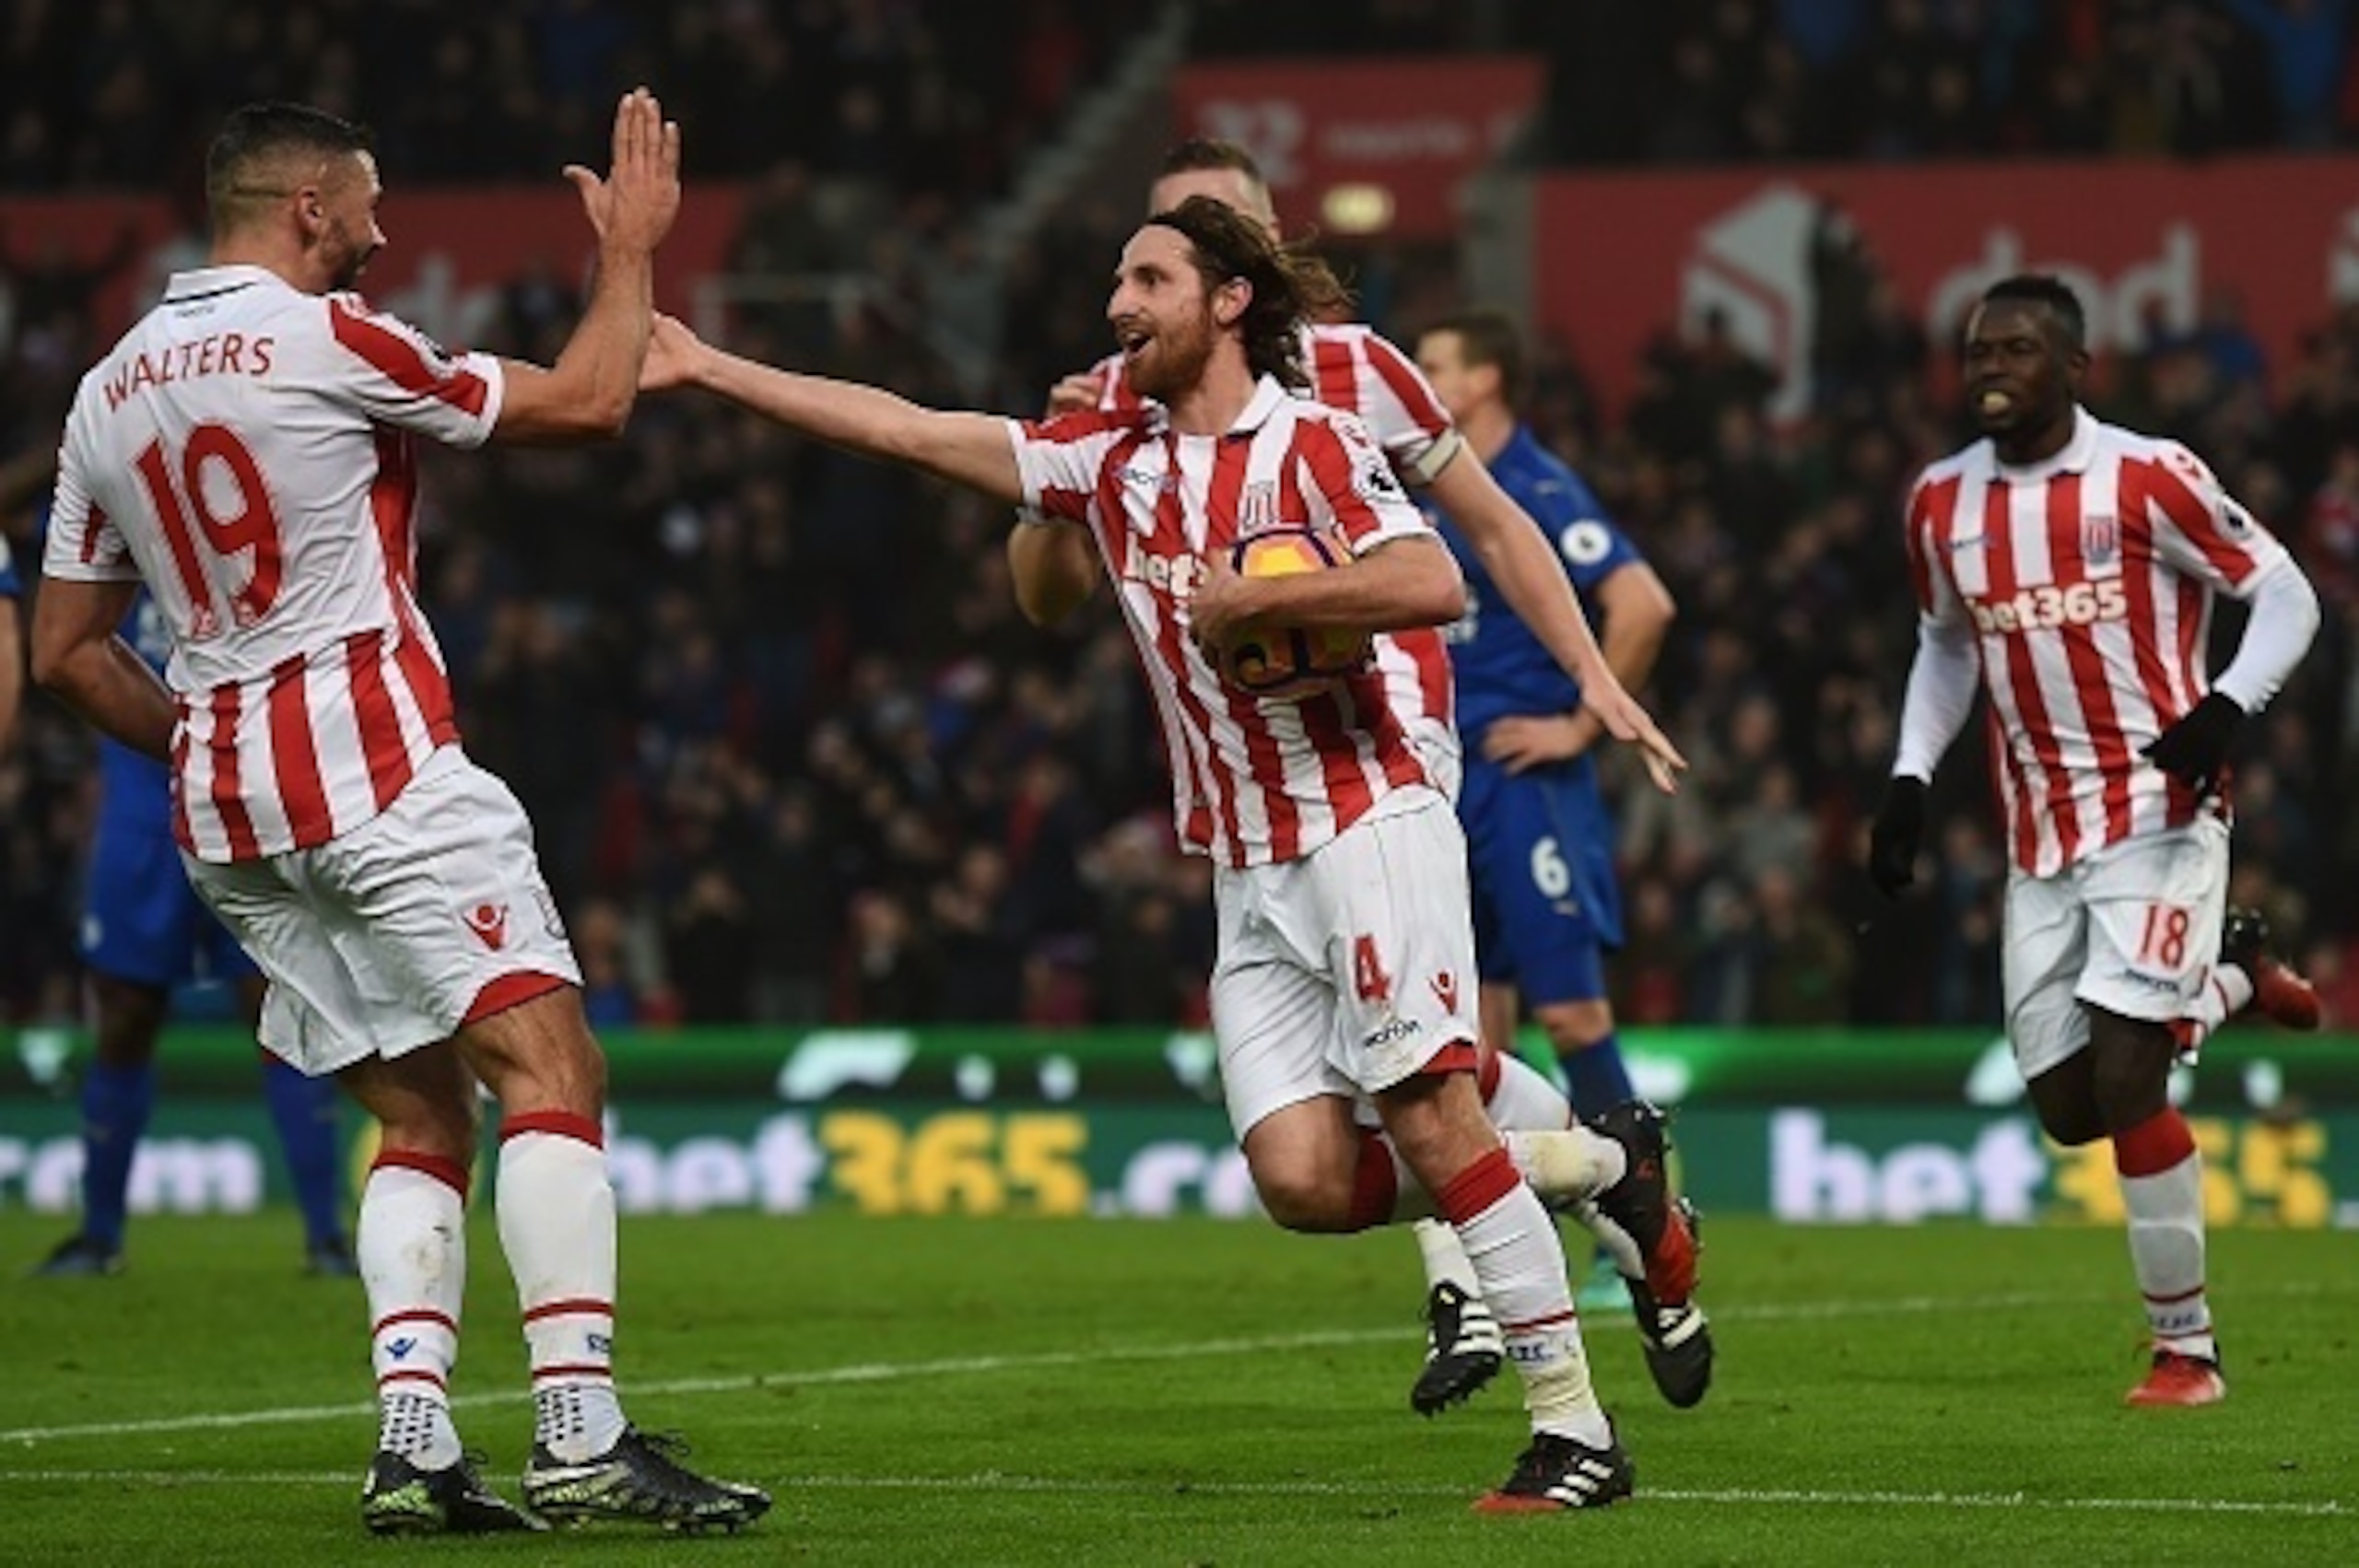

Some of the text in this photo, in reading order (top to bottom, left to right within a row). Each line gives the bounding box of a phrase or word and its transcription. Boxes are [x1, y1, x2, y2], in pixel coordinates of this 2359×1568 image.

[103, 333, 275, 413] WALTERS
[132, 421, 285, 639] 19
[1964, 579, 2128, 633] bet365
[1531, 835, 1571, 899] 6
[1355, 932, 1391, 1002] 4
[2136, 903, 2189, 970] 18
